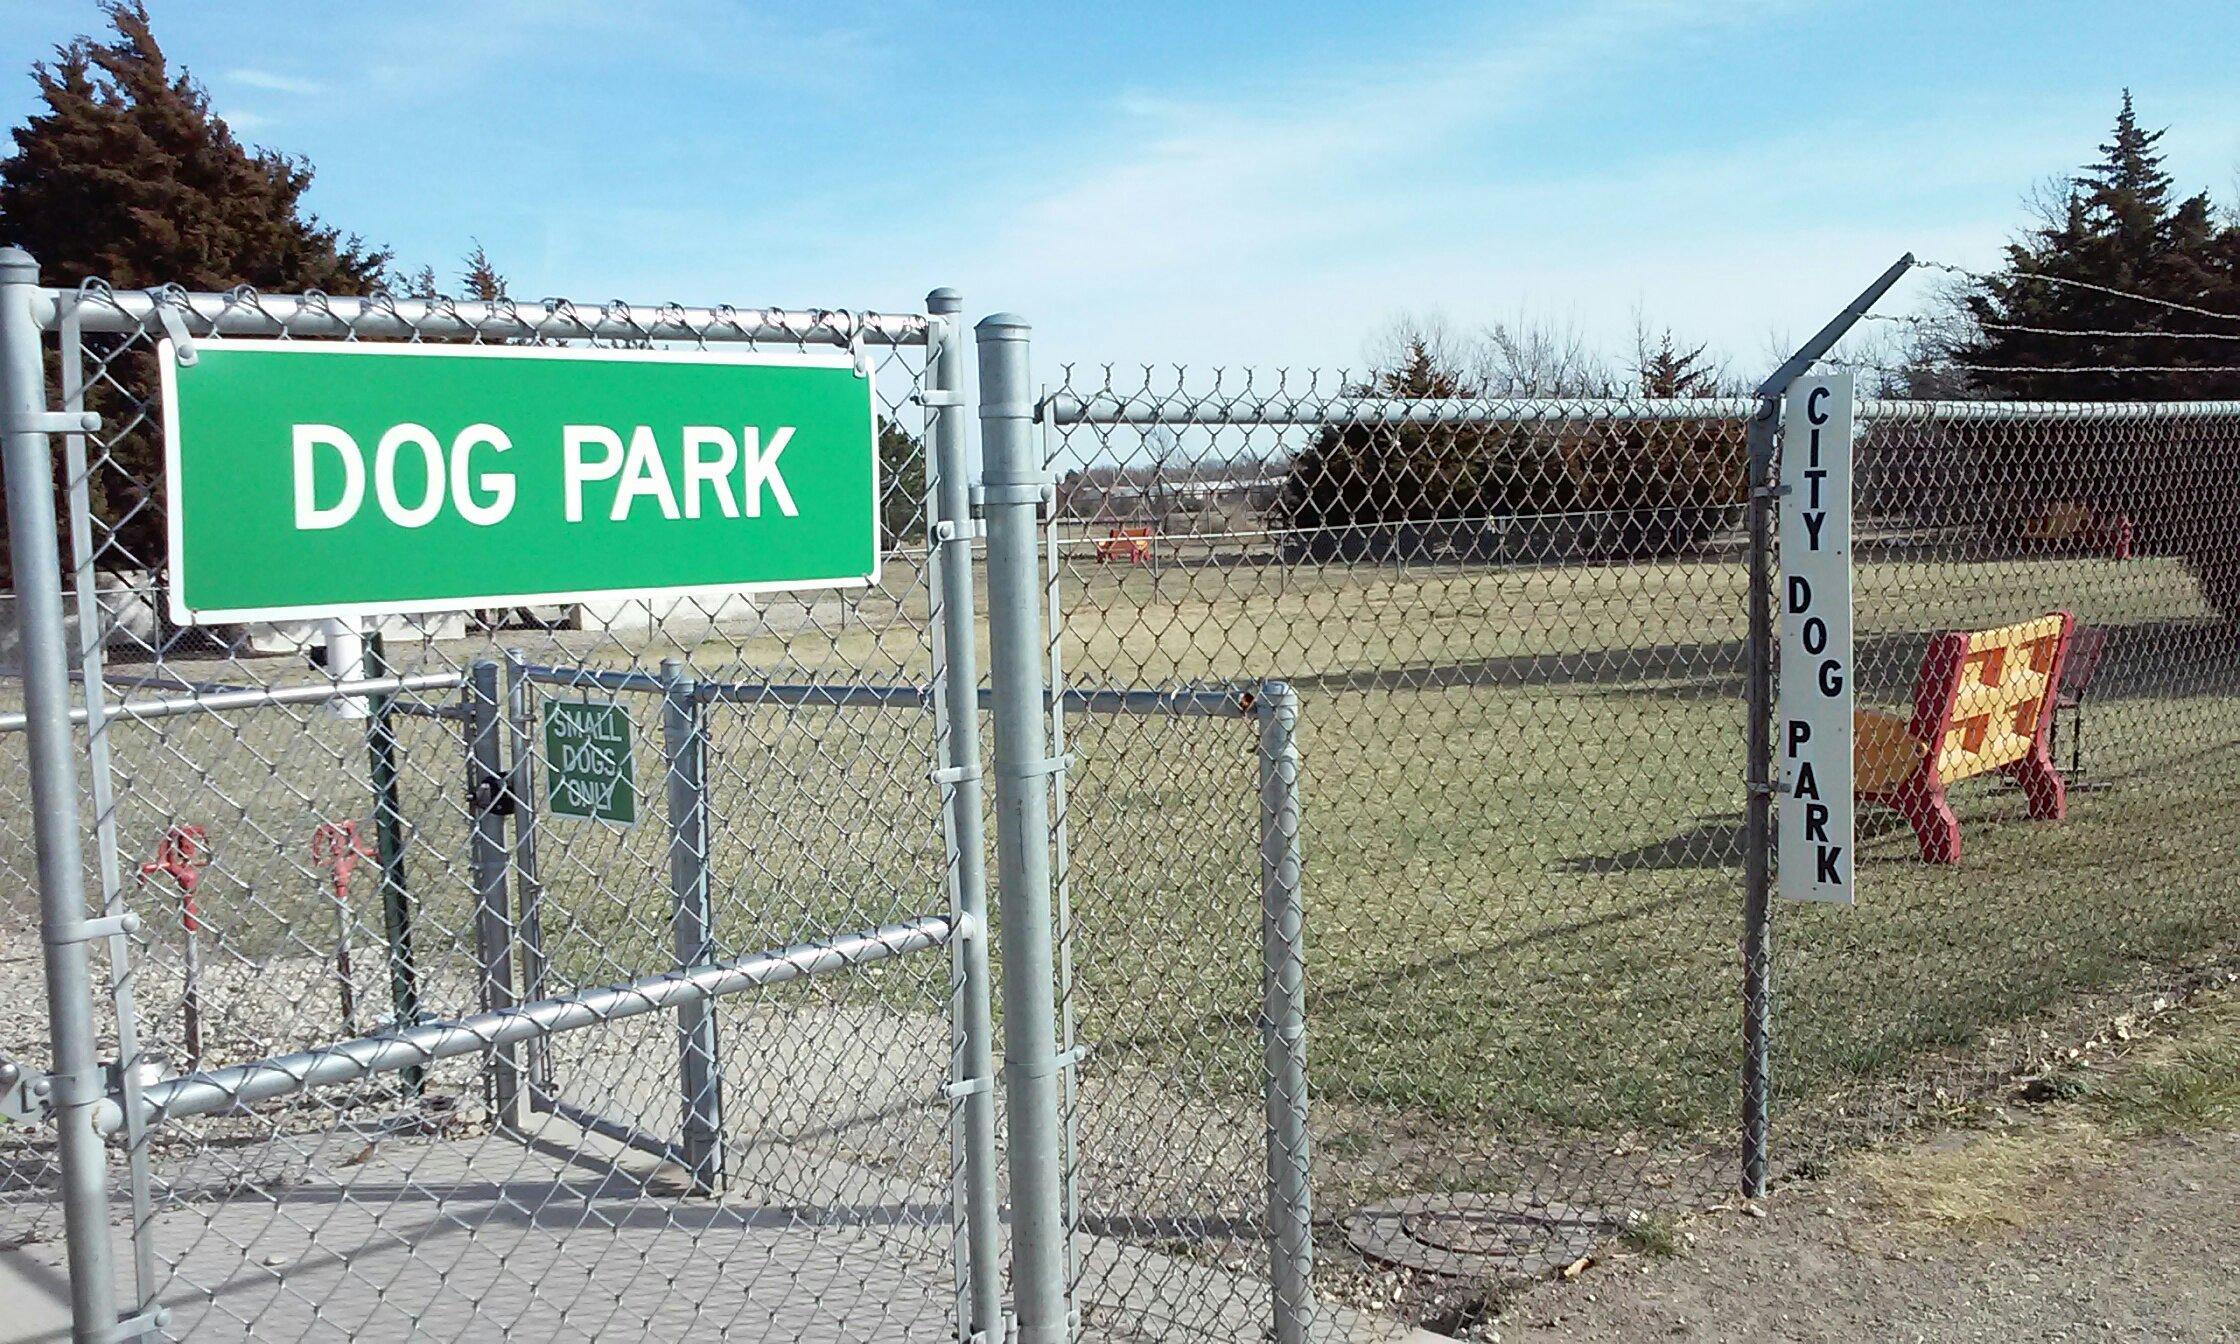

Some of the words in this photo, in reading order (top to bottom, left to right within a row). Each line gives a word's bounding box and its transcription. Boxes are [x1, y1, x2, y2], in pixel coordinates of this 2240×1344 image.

[292, 422, 517, 531] DOG
[562, 425, 800, 522] PARK
[1802, 386, 1831, 552] CITY
[1788, 575, 1844, 698] DOG
[554, 710, 622, 742] SMALL
[562, 744, 616, 776] DOGS
[567, 779, 616, 811] ONLY
[1788, 720, 1843, 885] PARK
